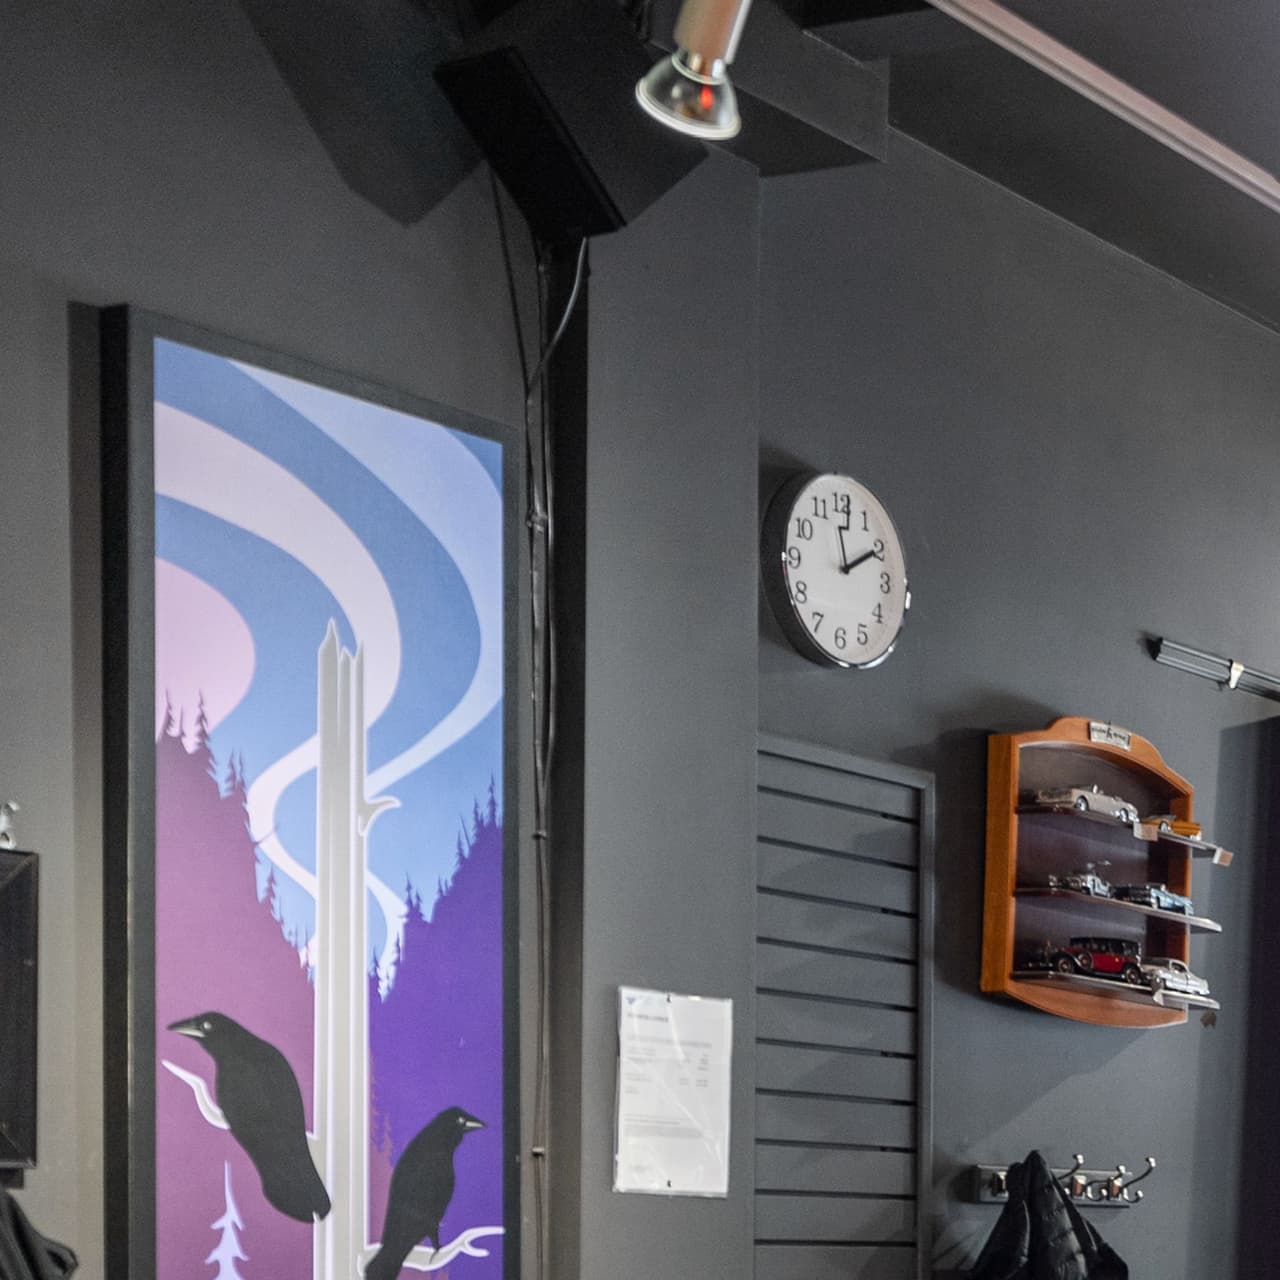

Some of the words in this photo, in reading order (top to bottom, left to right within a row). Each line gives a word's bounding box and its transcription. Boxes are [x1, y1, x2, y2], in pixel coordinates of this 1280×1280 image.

[812, 497, 828, 519] 11
[832, 492, 850, 515] 12
[796, 518, 813, 540] 10
[860, 511, 869, 532] 1
[788, 546, 800, 569] 9
[873, 539, 884, 561] 2
[795, 581, 807, 604] 8
[880, 572, 890, 594] 3
[812, 611, 824, 633] 7
[872, 602, 883, 624] 4
[834, 627, 846, 649] 6
[857, 624, 868, 645] 5
